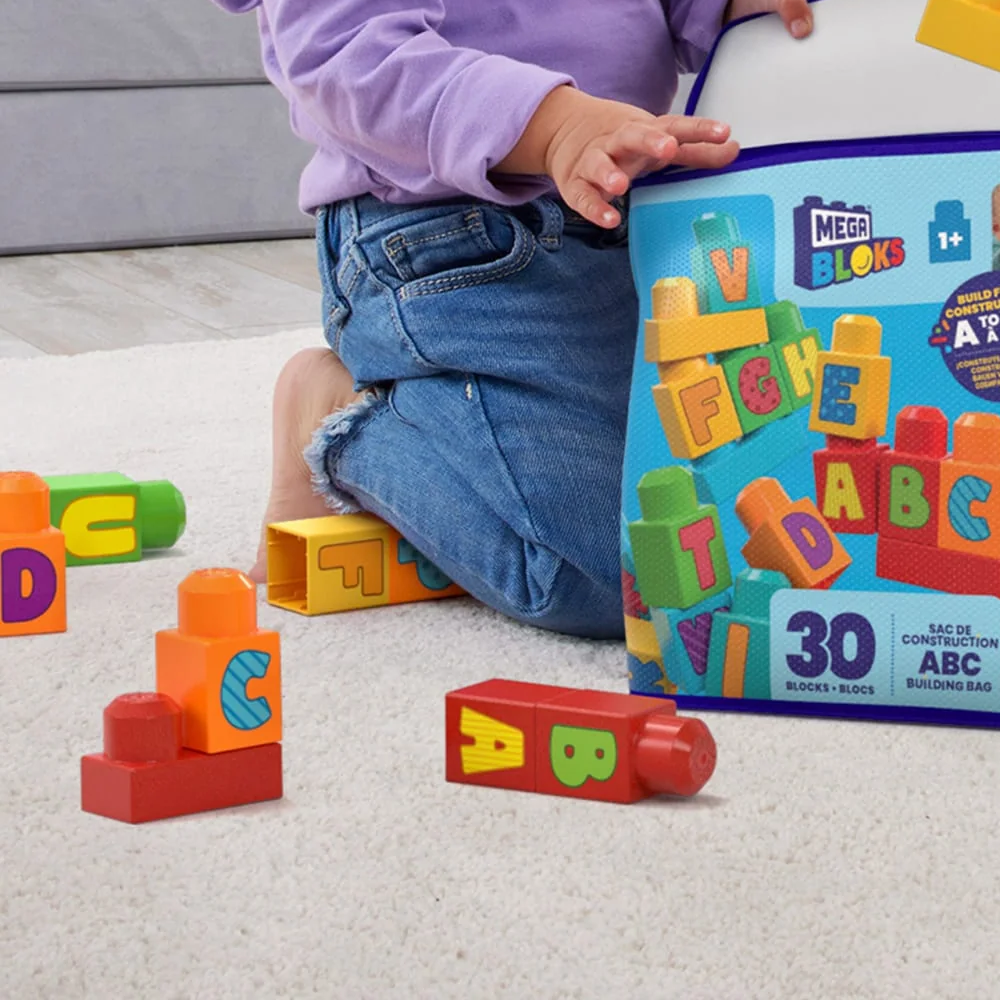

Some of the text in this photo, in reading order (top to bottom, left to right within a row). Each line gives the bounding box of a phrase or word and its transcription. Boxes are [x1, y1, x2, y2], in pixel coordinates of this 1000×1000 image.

[815, 214, 868, 242] MEGA
[937, 231, 963, 250] 1+
[709, 247, 749, 303] V
[811, 238, 905, 288] BLOKS
[957, 289, 993, 305] BUILD
[953, 319, 981, 349] A
[978, 314, 1000, 328] TO
[738, 356, 782, 415] G
[782, 336, 819, 398] H
[818, 362, 861, 426] E
[678, 376, 722, 446] F
[822, 462, 993, 542] A B C
[318, 538, 385, 597] F
[678, 515, 717, 591] T
[781, 511, 834, 571] D
[0, 547, 58, 623] D
[786, 610, 876, 681] 30
[901, 633, 1000, 649] CONSTRUCTION
[928, 623, 972, 636] SAC DE
[220, 649, 272, 731] C
[785, 680, 875, 695] BLOCKS BLOCS
[906, 678, 993, 693] BUILDING BAG
[918, 649, 982, 677] ABC
[460, 705, 618, 788] A B
